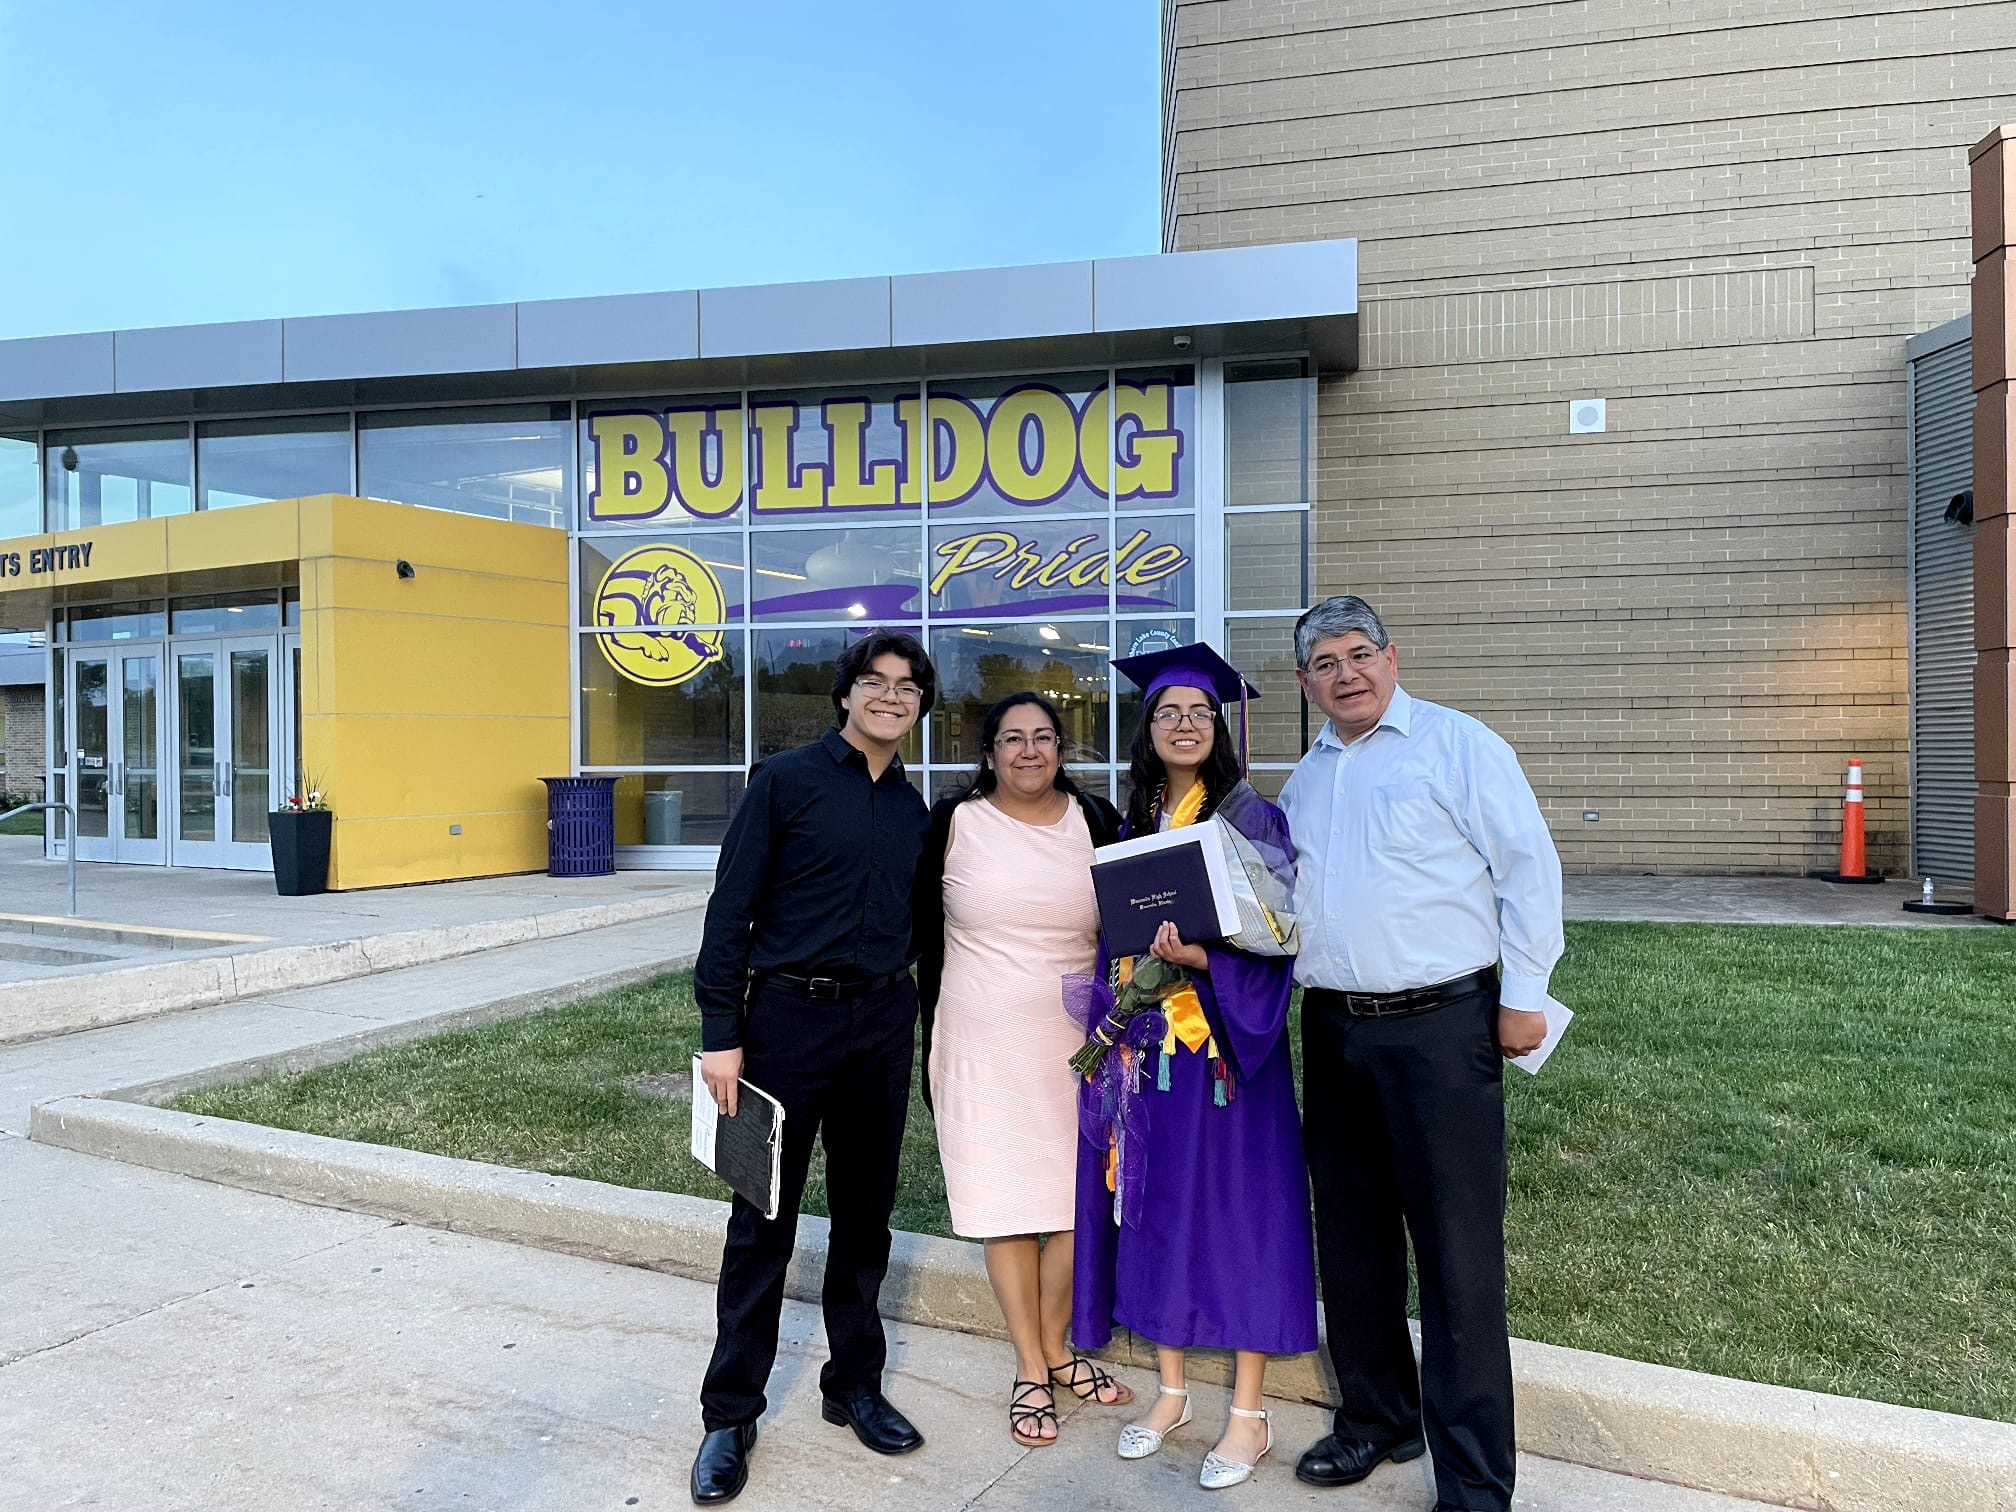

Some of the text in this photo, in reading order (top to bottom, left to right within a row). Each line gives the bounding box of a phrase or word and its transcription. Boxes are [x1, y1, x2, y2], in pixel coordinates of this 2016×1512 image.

[589, 380, 1183, 521] BULLDOG
[30, 542, 93, 574] ENTRY
[929, 528, 1190, 596] Pride
[1136, 632, 1149, 643] Lake
[1150, 629, 1170, 639] County
